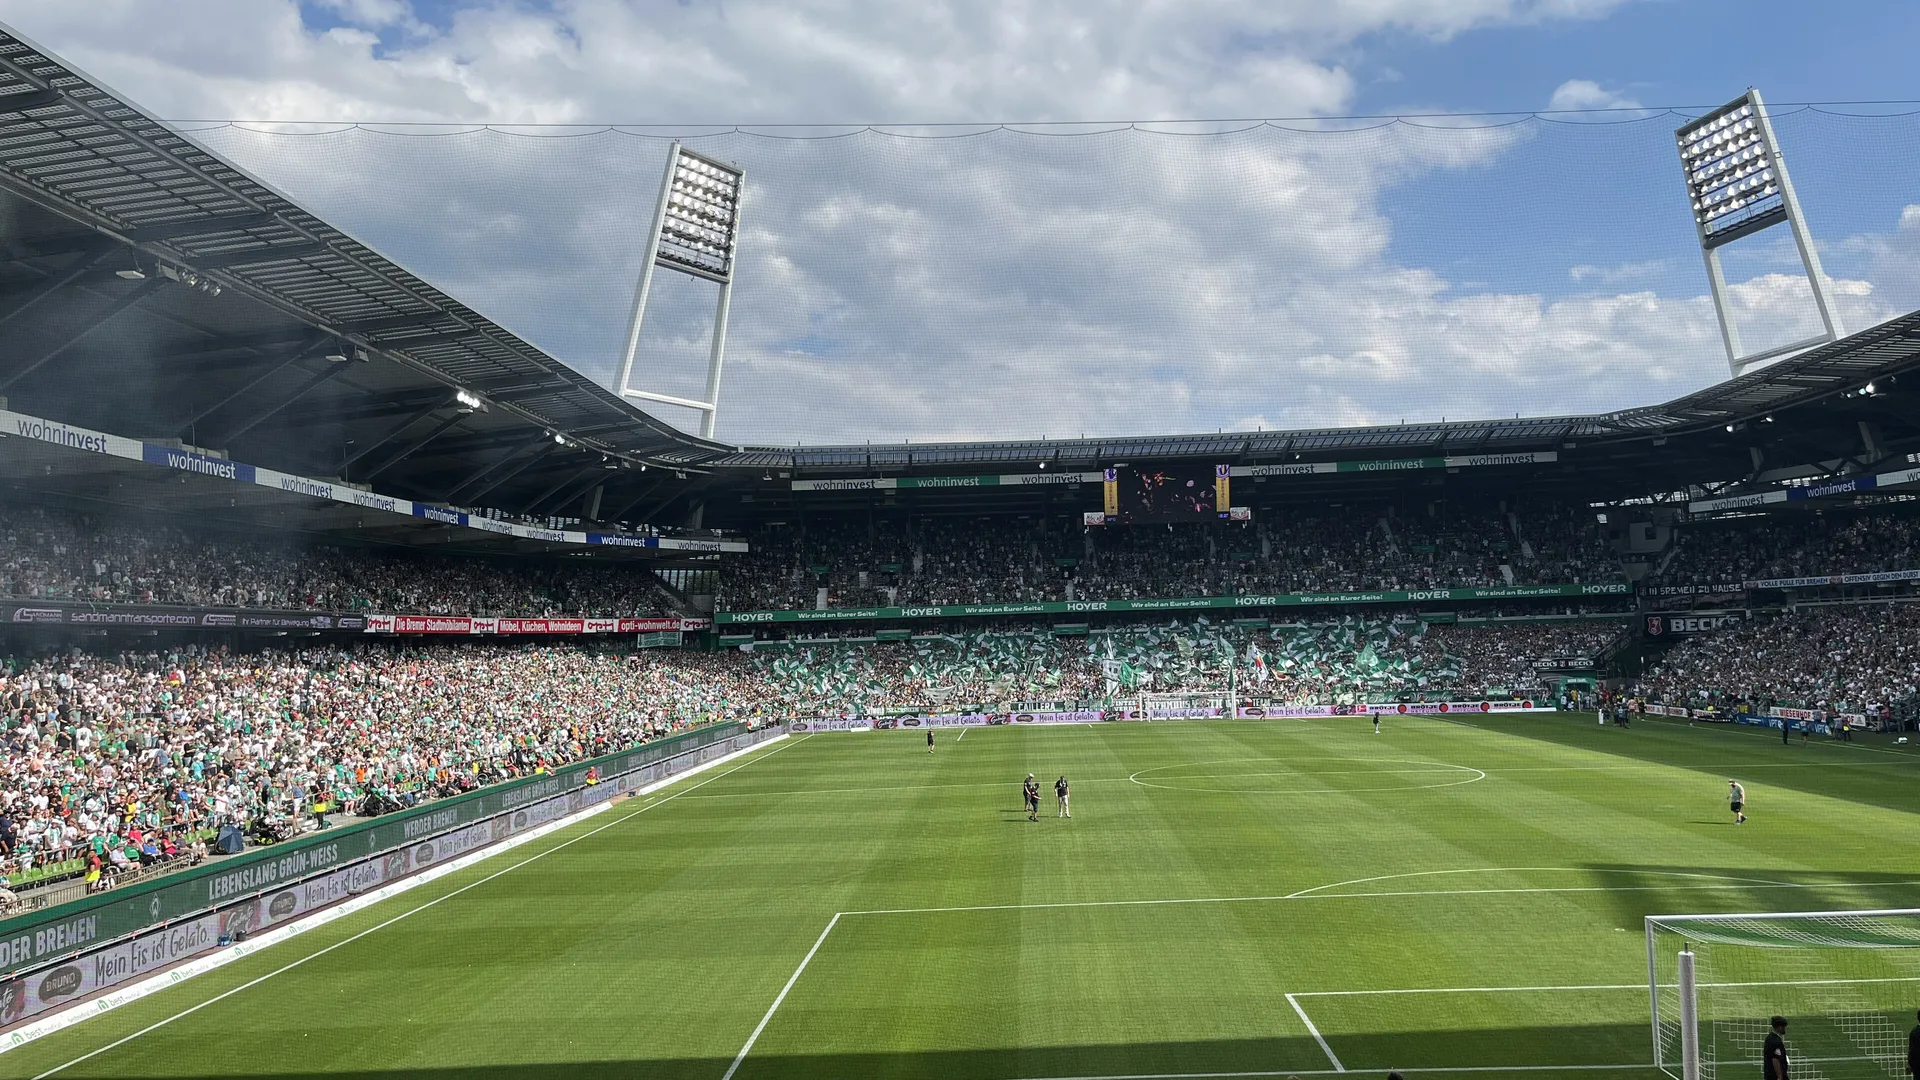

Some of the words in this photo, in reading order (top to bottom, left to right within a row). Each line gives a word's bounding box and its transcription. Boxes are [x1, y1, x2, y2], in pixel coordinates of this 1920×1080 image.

[18, 418, 107, 454] wohninvest
[1358, 458, 1424, 471] wohninvest
[1468, 453, 1535, 466] wohninvest
[168, 452, 236, 480] wohninvest
[1252, 464, 1315, 476] wohninvest
[813, 479, 876, 490] wohninvest
[917, 476, 980, 488] wohninvest
[1021, 473, 1084, 484] wohninvest
[281, 476, 332, 499] wohninvest
[1807, 481, 1856, 498] wohninvest
[353, 492, 396, 512] wohninvest
[1712, 494, 1764, 510] wohninvest
[424, 508, 458, 524] wohninvest
[482, 520, 512, 535] wohninvest
[526, 528, 564, 542] wohninvest
[601, 536, 646, 548] wohninvest
[678, 541, 720, 551] wohninvest
[1582, 584, 1626, 594] HOYER
[1698, 585, 1710, 594] ZU
[1712, 583, 1742, 593] HAUSE
[1235, 596, 1276, 606] HOYER
[1408, 590, 1450, 600] HOYER
[902, 608, 942, 616] HOYER
[1067, 602, 1107, 611] HOYER
[71, 612, 196, 625] sandmanntransporte.com
[732, 612, 774, 622] HOYER
[396, 618, 406, 630] Die
[500, 620, 520, 633] Möbel,
[522, 620, 548, 633] Küchen,
[550, 620, 582, 632] Wohnideen
[621, 620, 680, 632] opti-wohnwelt.de
[1018, 702, 1056, 712] CAILLERA
[1269, 706, 1284, 716] Mein
[1286, 706, 1294, 714] Eis
[926, 718, 941, 726] Mein
[942, 717, 950, 726] Eis
[1039, 714, 1054, 722] Mein
[1056, 713, 1064, 722] Eis
[404, 817, 432, 839] WERDER
[433, 808, 458, 829] BREMEN
[209, 864, 276, 900] LEBENSLANG
[279, 843, 338, 878] GRÜN-WEISS
[304, 884, 325, 908] Mein
[328, 876, 338, 900] Eis
[340, 872, 350, 894] ist
[36, 914, 96, 951] BREMEN
[95, 953, 126, 987] Mein
[130, 942, 148, 974] Eis
[152, 938, 166, 966] ist
[170, 922, 210, 957] Gelato.
[46, 972, 76, 992] BRUNO
[24, 1028, 44, 1040] best
